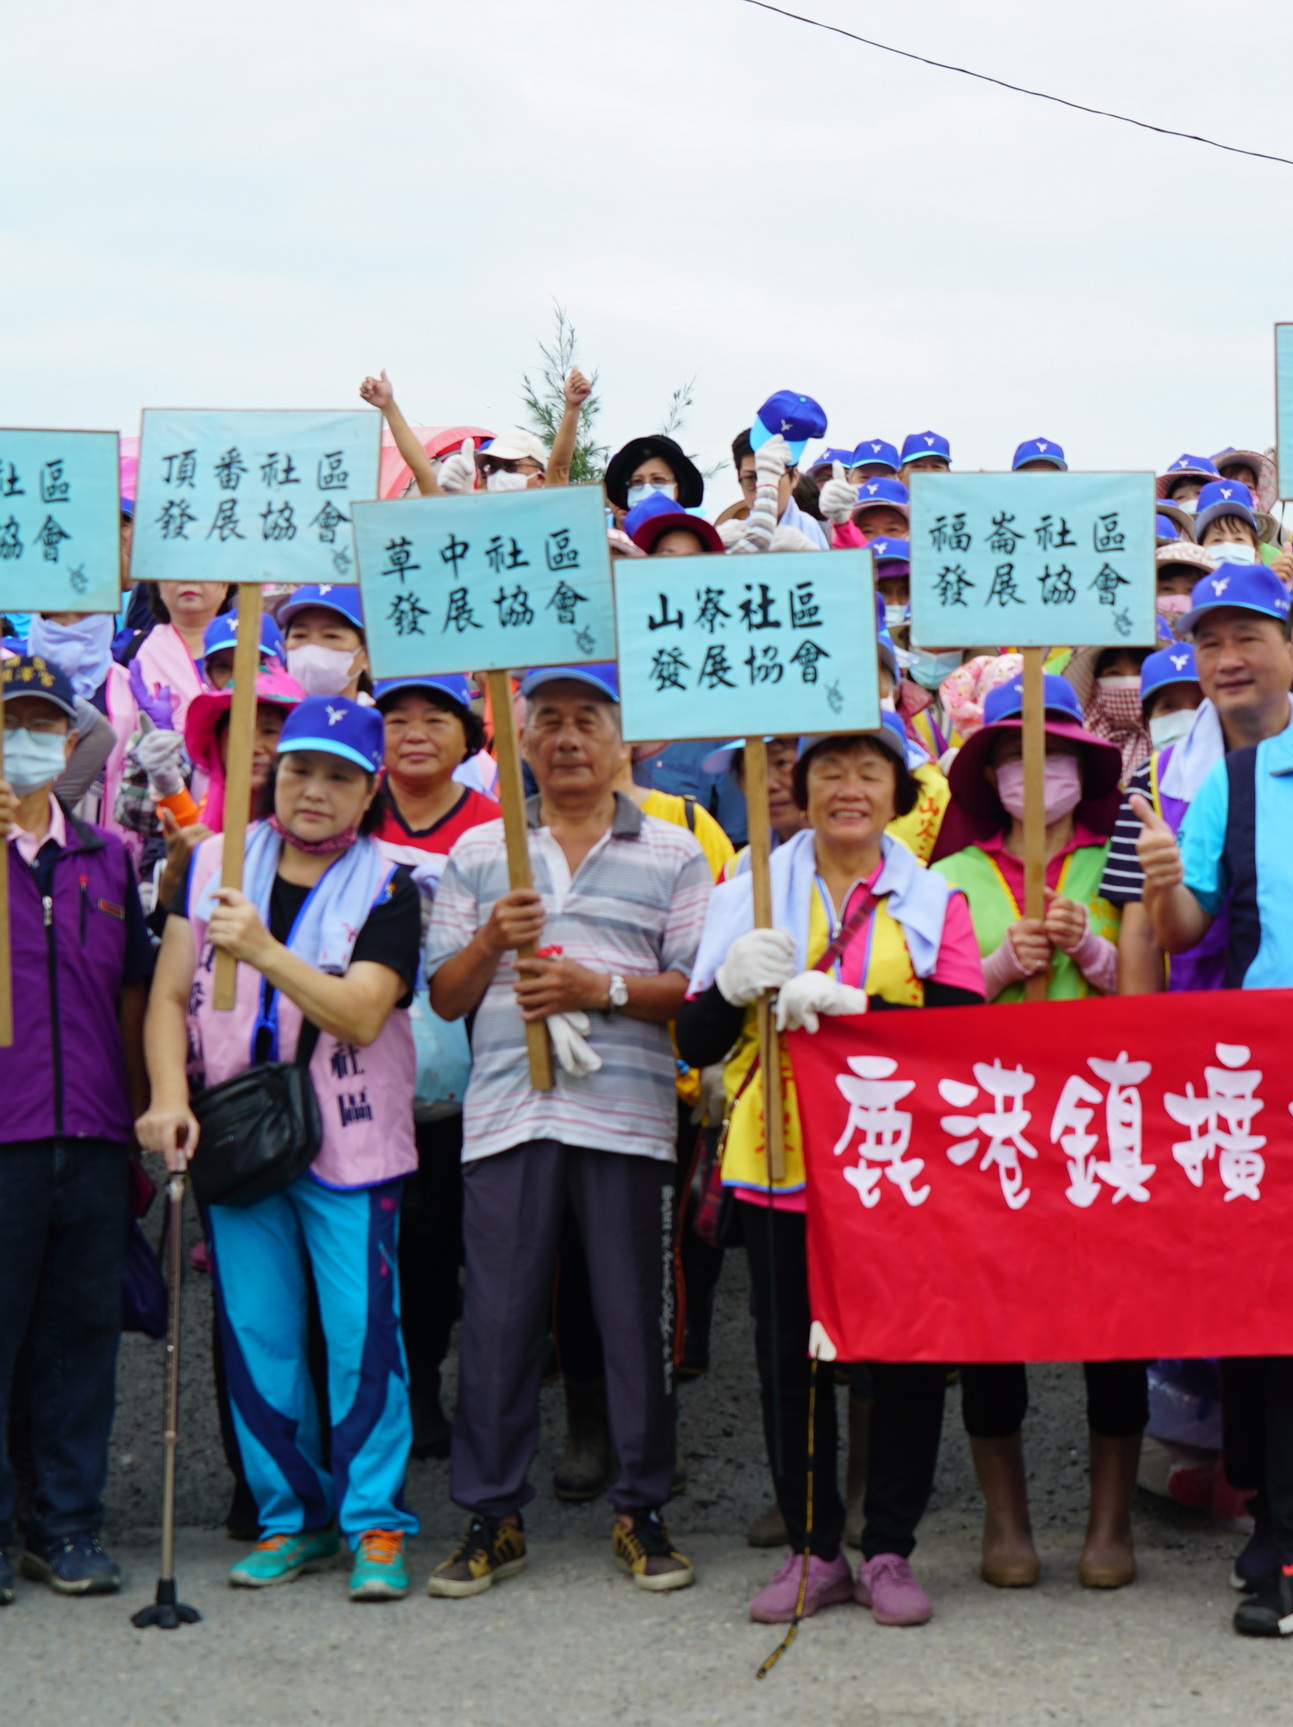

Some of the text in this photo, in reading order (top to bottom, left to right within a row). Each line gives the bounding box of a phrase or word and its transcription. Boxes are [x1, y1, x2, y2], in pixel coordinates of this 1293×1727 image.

[161, 446, 350, 491] 頂番社區
[154, 498, 353, 543] 發展協會
[929, 510, 1125, 555] 福崙社區
[381, 528, 580, 584] 草中社區
[386, 580, 590, 636] 發展協會
[648, 582, 823, 634] 山寮社區
[931, 562, 1131, 608] 發展協會
[648, 639, 832, 692] 發展協會
